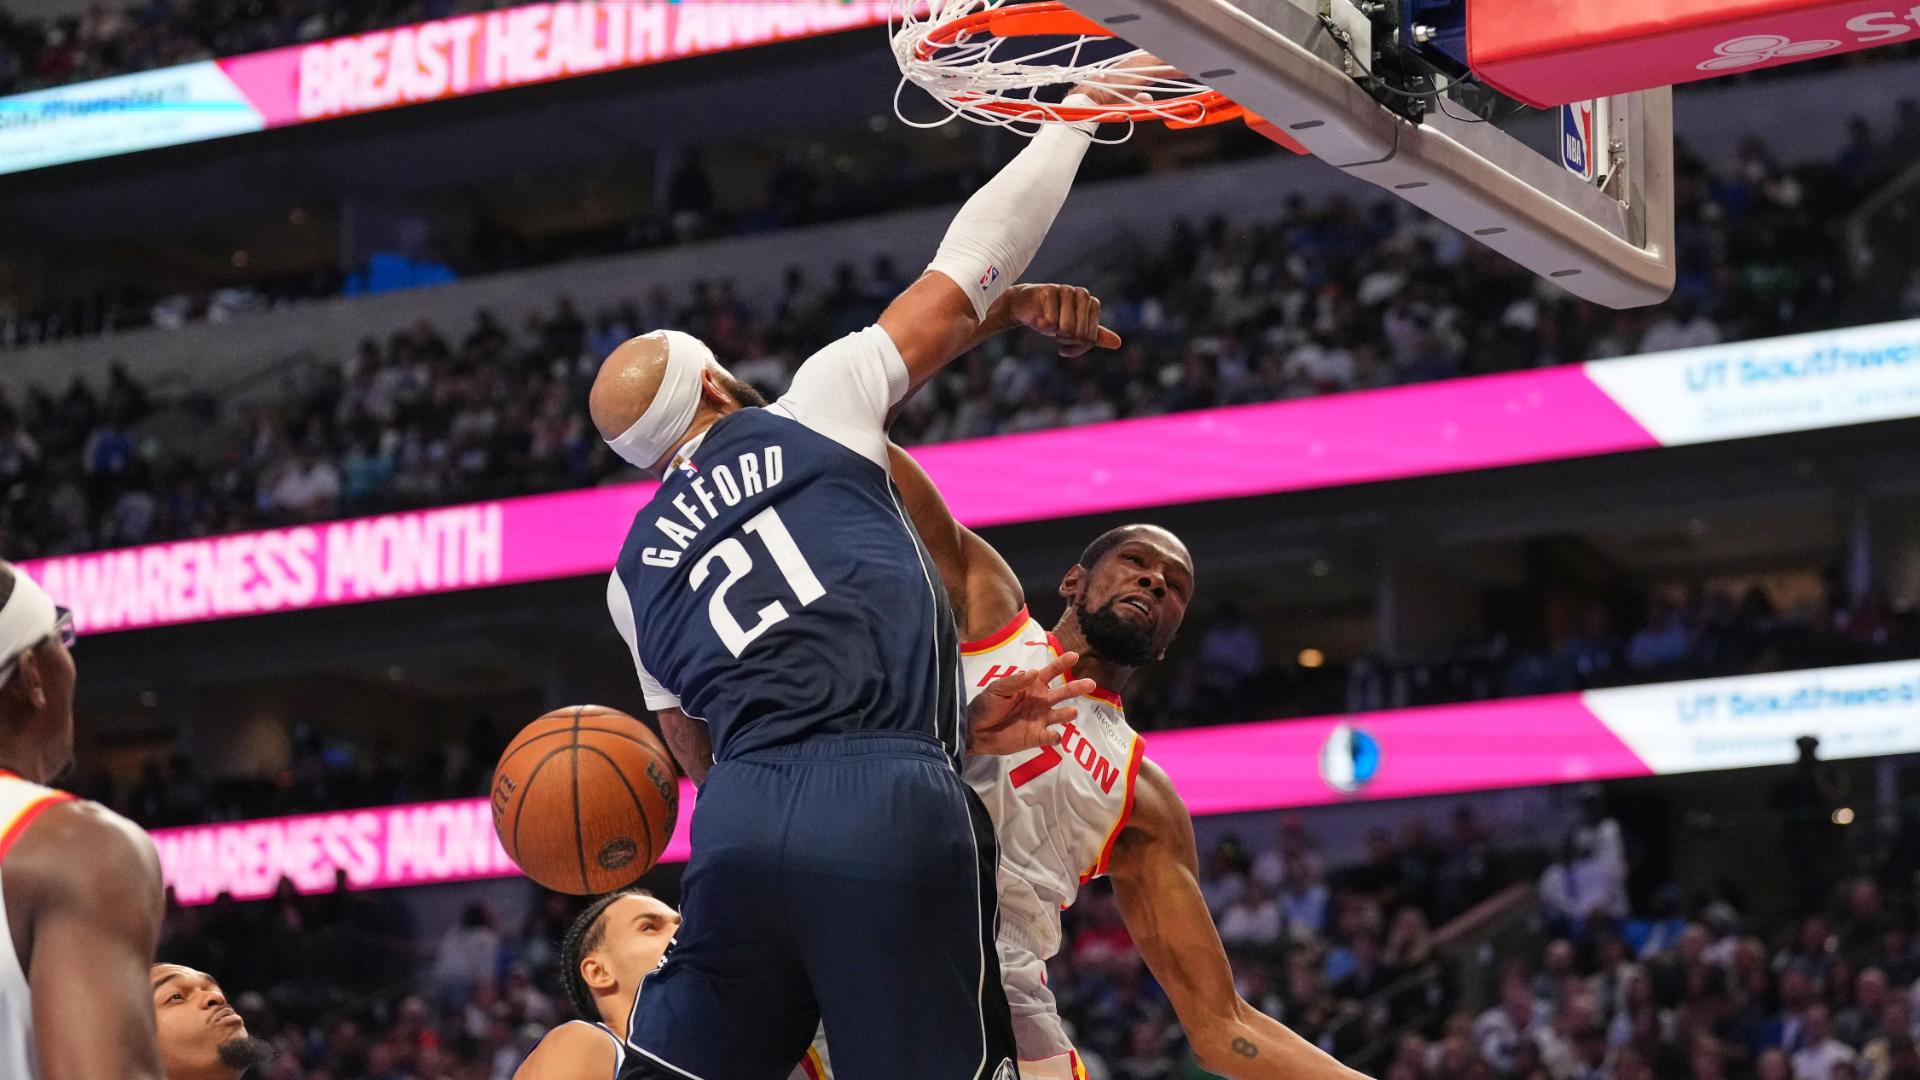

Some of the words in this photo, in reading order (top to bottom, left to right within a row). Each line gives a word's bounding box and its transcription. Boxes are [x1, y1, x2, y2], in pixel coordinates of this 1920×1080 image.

[299, 17, 477, 119] BREAST
[485, 0, 662, 86] HEALTH
[1566, 132, 1582, 167] NBA
[325, 502, 504, 602] MONTH
[641, 445, 783, 569] GAFFORD
[689, 505, 827, 659] 21
[976, 664, 1120, 795] HTON
[148, 811, 380, 902] WARENESS
